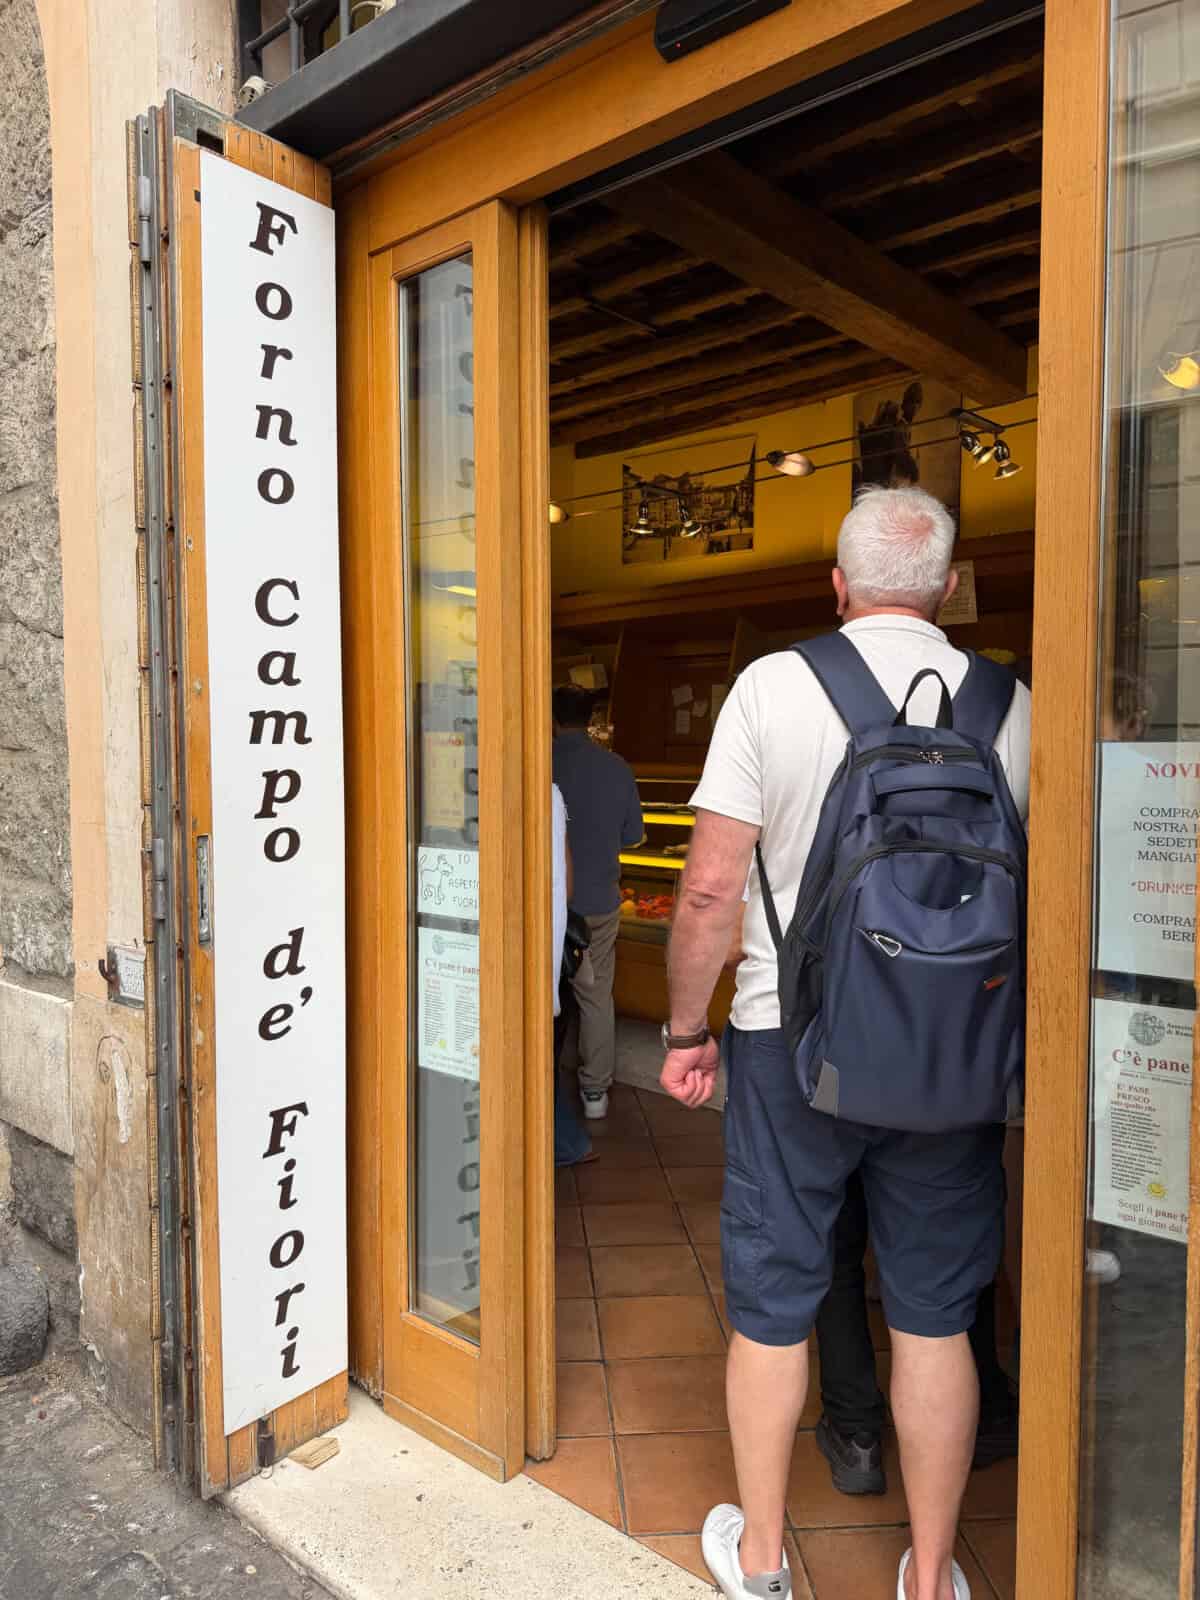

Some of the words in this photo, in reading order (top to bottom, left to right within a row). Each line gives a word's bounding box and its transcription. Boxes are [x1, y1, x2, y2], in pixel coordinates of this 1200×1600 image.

[249, 201, 299, 505] Forno
[248, 578, 313, 863] Campo
[1133, 821, 1188, 833] NOSTRA
[1140, 806, 1200, 818] COMPRA
[258, 926, 313, 1041] de'
[1147, 1057, 1190, 1073] pane
[262, 1101, 309, 1379] Fiori
